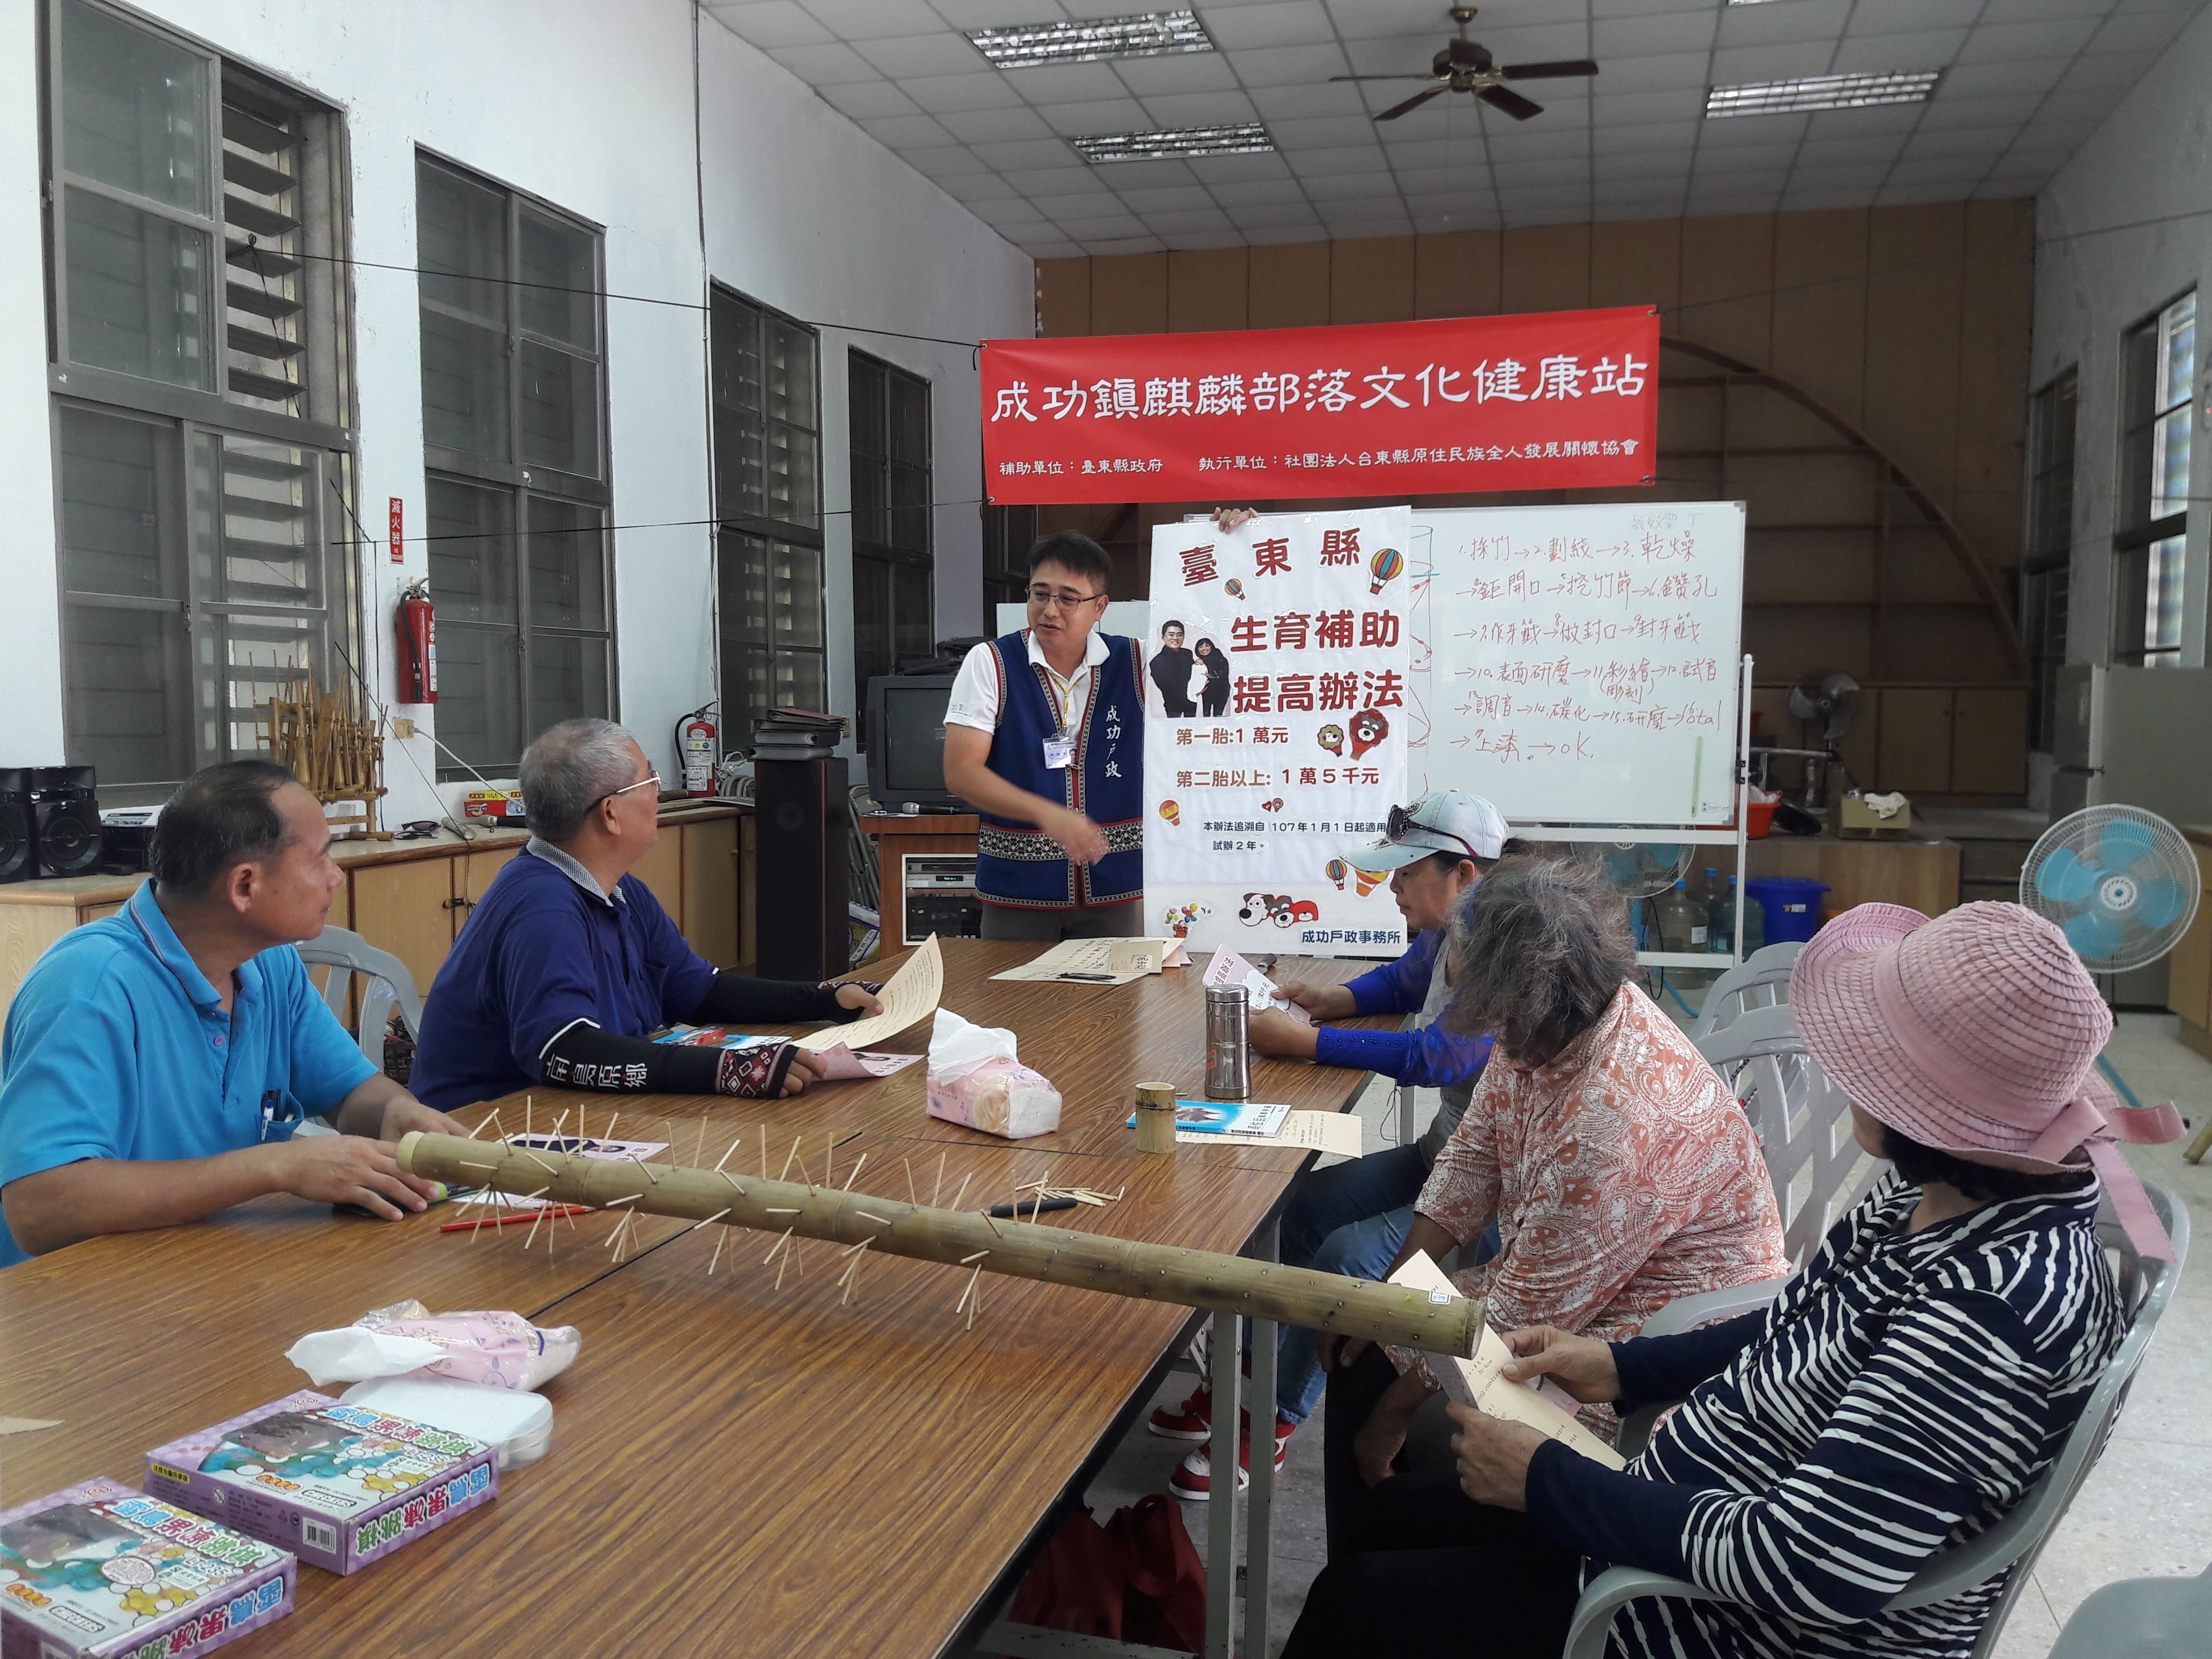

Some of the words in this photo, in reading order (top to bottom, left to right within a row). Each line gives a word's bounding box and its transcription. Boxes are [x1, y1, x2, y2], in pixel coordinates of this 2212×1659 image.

[991, 353, 1650, 422] 成功鎮麒麟部落文化健康站
[391, 499, 401, 545] 滅火器
[1230, 609, 1400, 652] 生育補助
[1233, 669, 1403, 714] 提高辦法
[1301, 930, 1402, 945] 成功戶政事務所
[545, 1052, 648, 1089] 南島原鄉
[356, 1462, 490, 1556] 雷鳥果凍跳棋
